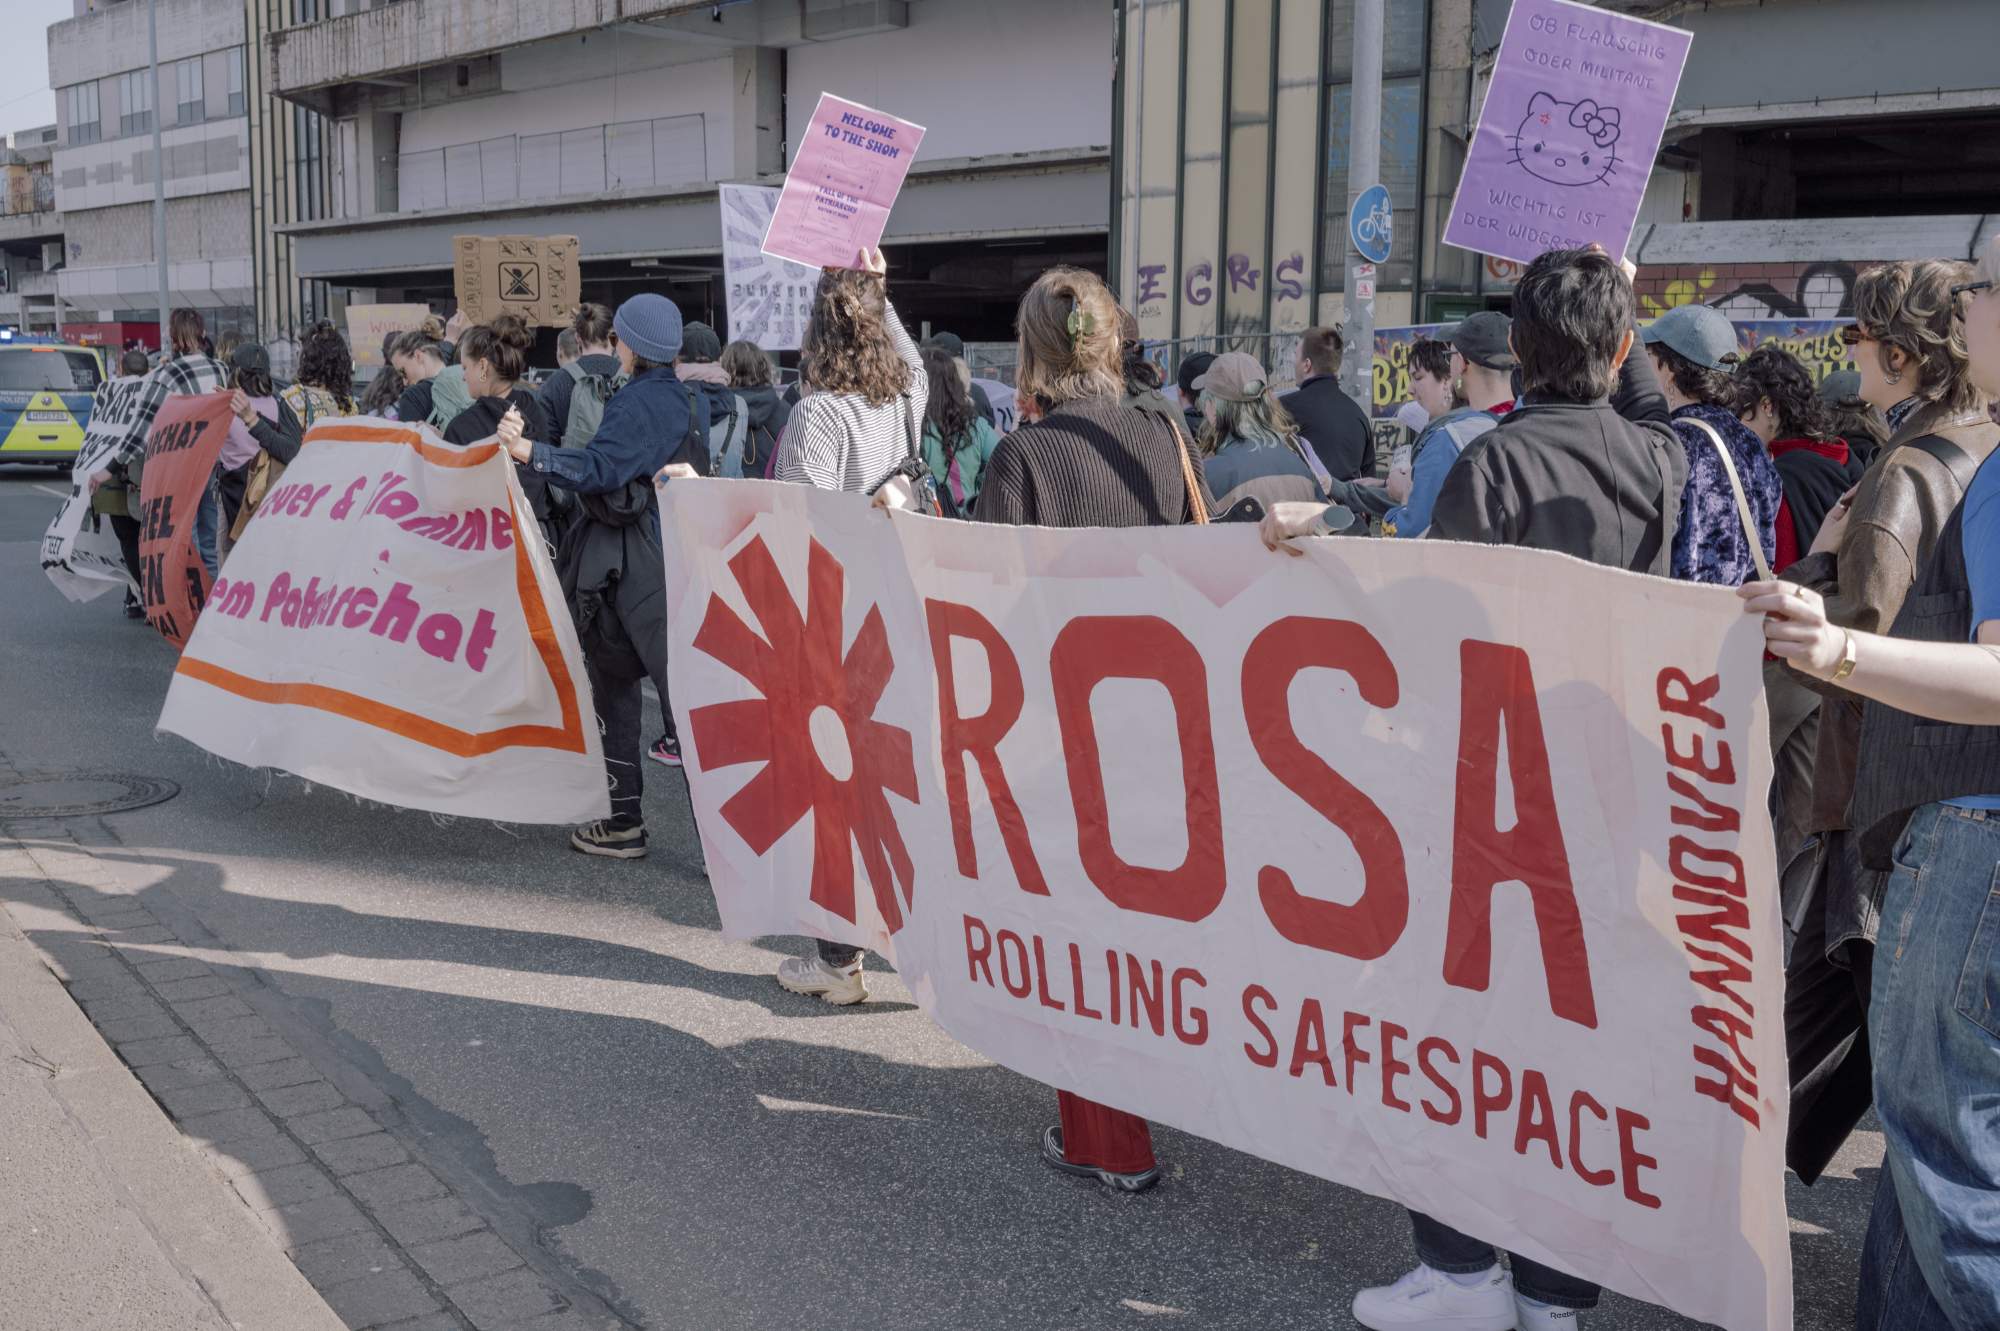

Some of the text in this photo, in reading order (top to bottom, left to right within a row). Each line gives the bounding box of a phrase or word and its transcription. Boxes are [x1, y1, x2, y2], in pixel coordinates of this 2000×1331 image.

[1529, 13, 1666, 60] OB FLAUSCHIG
[1523, 47, 1655, 90] ODER MILITANT
[824, 123, 900, 159] TO THE SHOW
[841, 111, 897, 140] WELCOME
[1488, 188, 1606, 228] WICHTIG IST
[1463, 212, 1585, 252] DER WIDERST
[1373, 355, 1414, 407] BA
[924, 596, 1598, 1030] ROSA
[1656, 666, 1761, 1131] HANNOVER
[962, 913, 1662, 1209] ROLLING SAFESPACE
